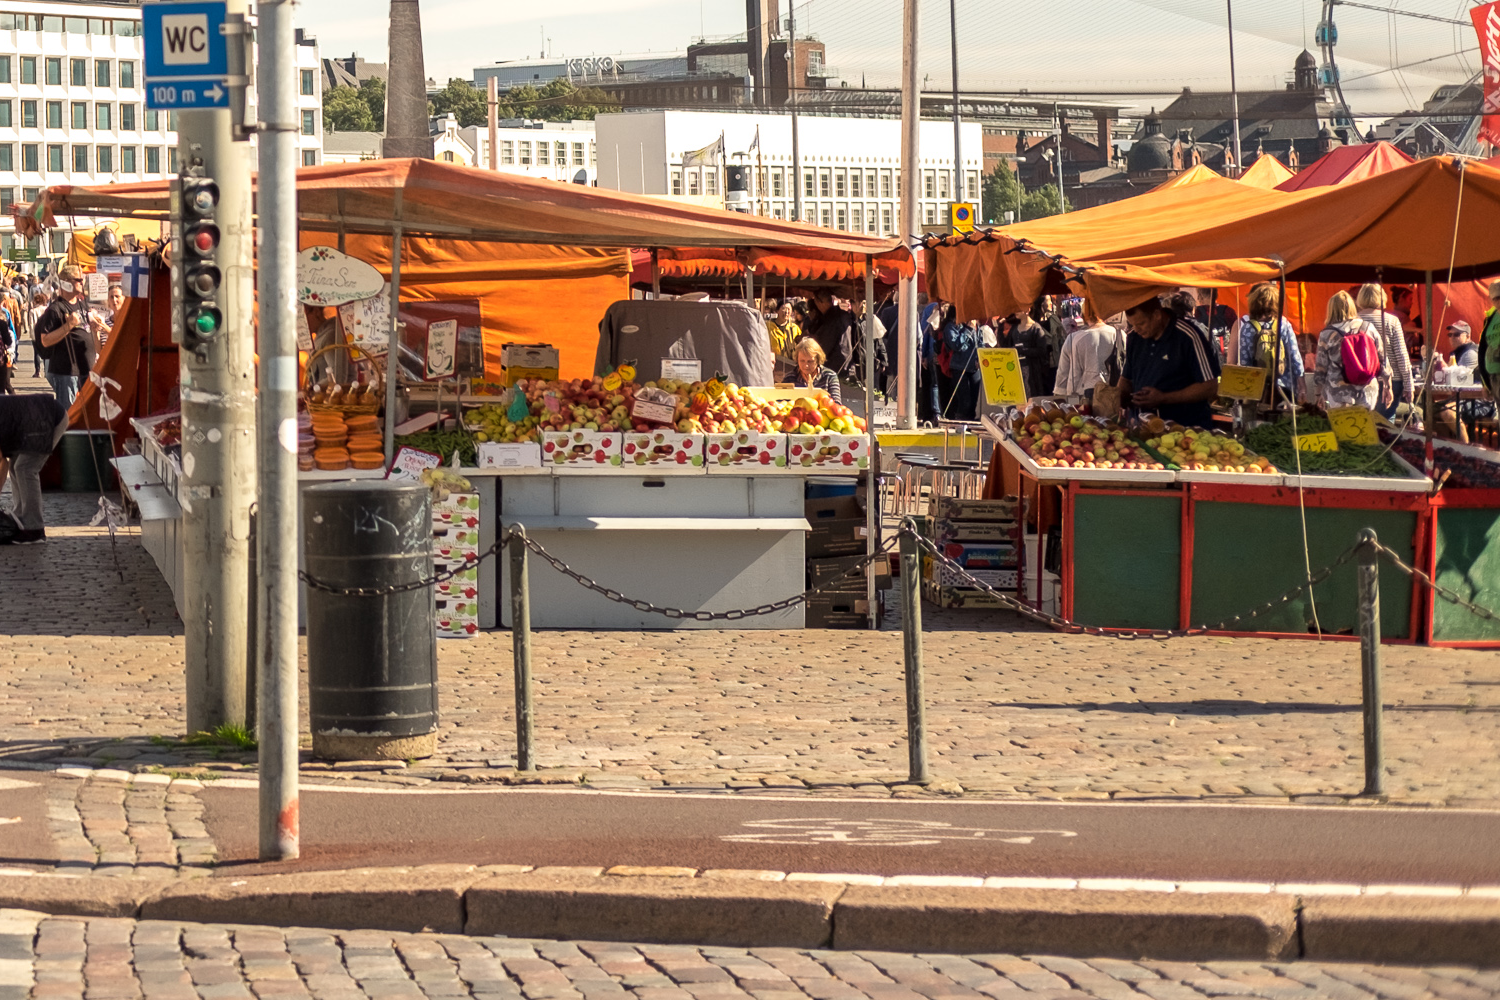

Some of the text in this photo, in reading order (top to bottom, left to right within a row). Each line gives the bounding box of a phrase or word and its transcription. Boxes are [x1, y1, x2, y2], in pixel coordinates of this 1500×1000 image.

[165, 26, 205, 53] WC
[565, 56, 614, 72] KESKO
[153, 86, 196, 103] 100 m
